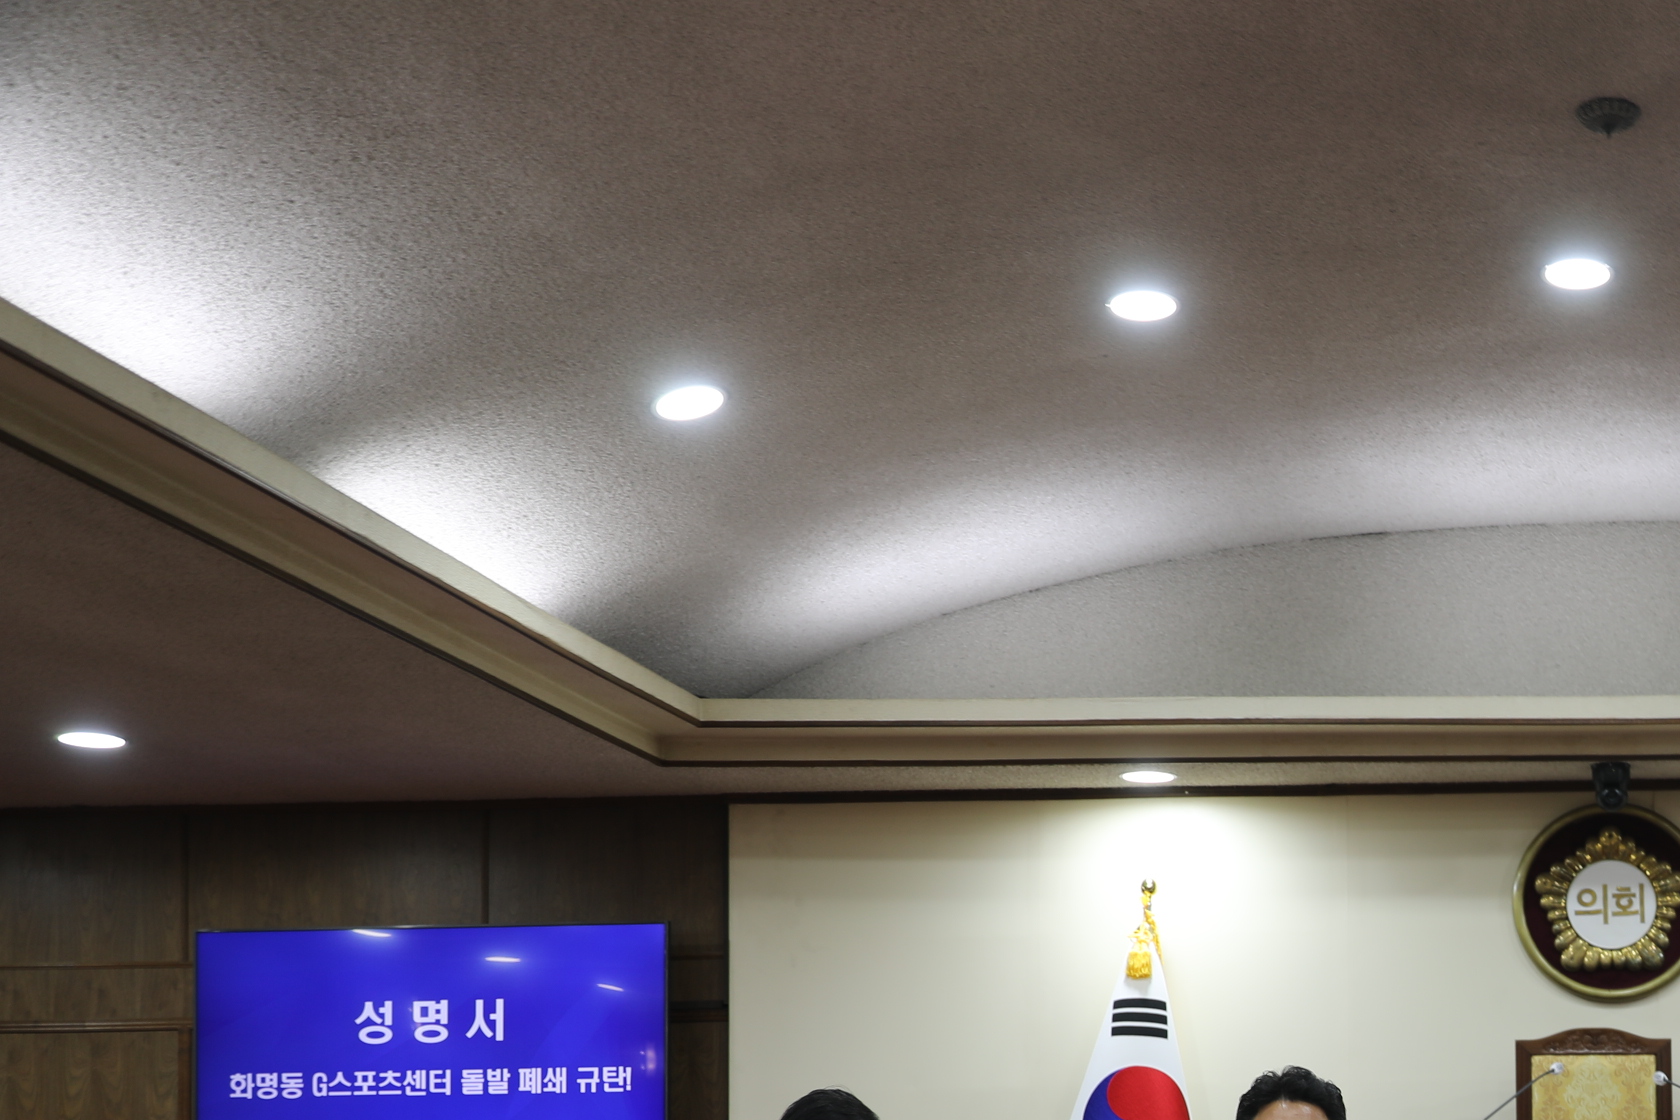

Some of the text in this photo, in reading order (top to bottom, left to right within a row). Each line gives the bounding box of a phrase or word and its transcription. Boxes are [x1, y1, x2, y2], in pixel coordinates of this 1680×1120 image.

[1575, 883, 1645, 924] 의회
[229, 1065, 632, 1100] 화명동 G스포츠센터 돌발 폐쇄 규탄!
